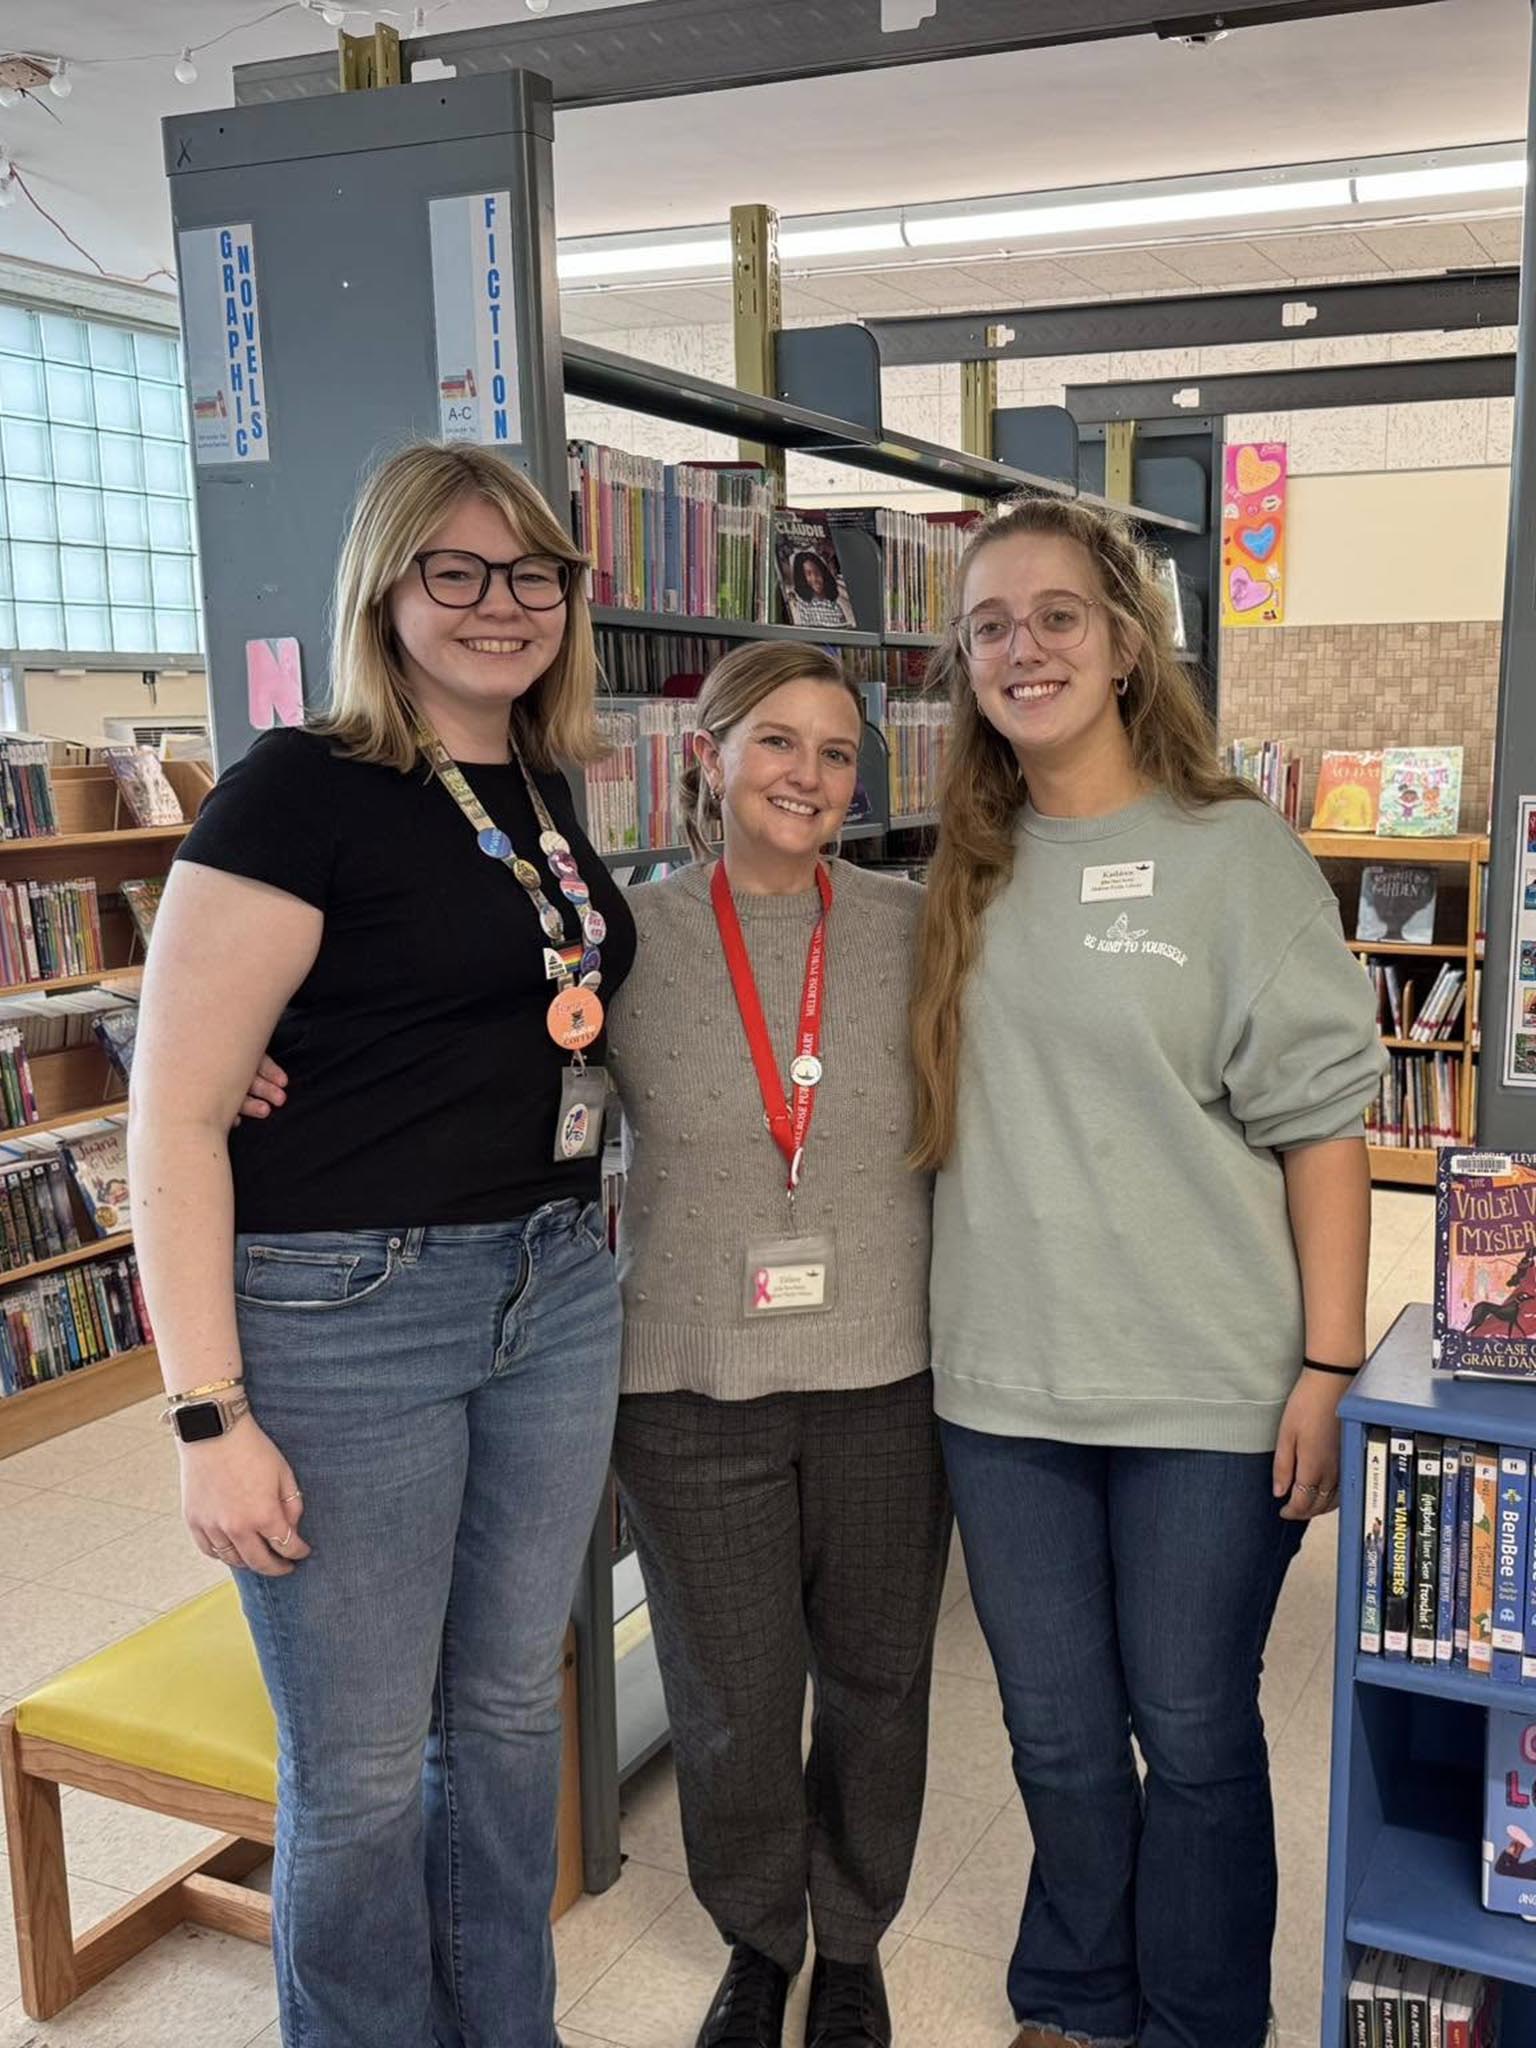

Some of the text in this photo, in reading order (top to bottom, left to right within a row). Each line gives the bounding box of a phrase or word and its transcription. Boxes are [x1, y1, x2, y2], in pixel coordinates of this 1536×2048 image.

[484, 197, 508, 440] FICTION
[219, 230, 248, 457] GRAPHIC
[237, 245, 263, 439] NOVELS
[448, 406, 472, 421] A-C
[776, 521, 826, 538] CLAUDIE
[246, 637, 304, 729] N
[810, 944, 822, 975] PUBLIC
[1097, 939, 1122, 953] KIND
[1124, 940, 1138, 953] TO
[1141, 940, 1188, 967] YOURSELF
[805, 975, 819, 1017] MELROSE
[79, 1135, 118, 1160] Juana
[1454, 1187, 1521, 1221] VIOLET
[1461, 1353, 1505, 1367] GRAVE
[1482, 1343, 1492, 1354] A
[1494, 1342, 1528, 1356] CASE
[1372, 1455, 1380, 1464] A
[1398, 1443, 1406, 1451] B
[1465, 1455, 1473, 1463] D
[1425, 1463, 1433, 1471] C
[1446, 1462, 1454, 1470] D
[1483, 1468, 1490, 1476] F
[1419, 1493, 1437, 1537] Anybody
[1392, 1489, 1408, 1595] THE VANQUISHERS
[1500, 1510, 1520, 1577] BenBee
[1421, 1560, 1433, 1580] Seen
[1418, 1583, 1433, 1630] Frenchie?
